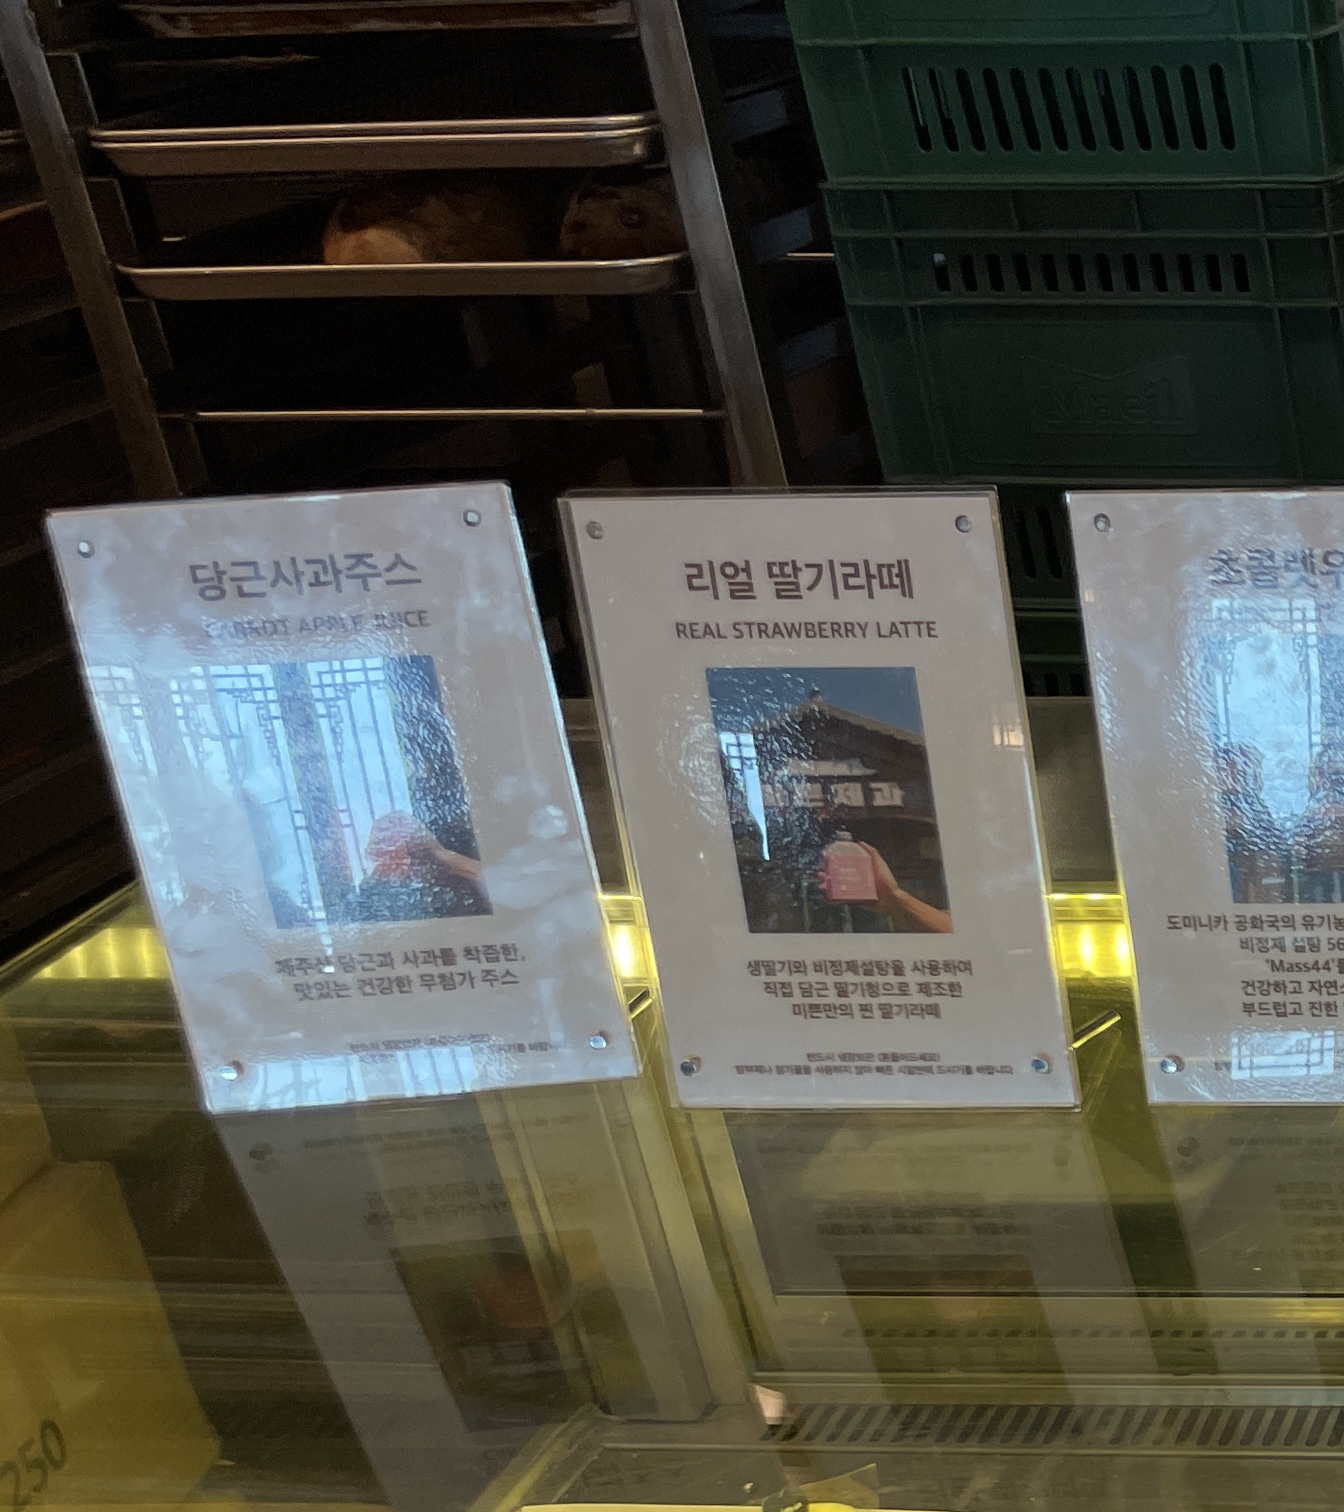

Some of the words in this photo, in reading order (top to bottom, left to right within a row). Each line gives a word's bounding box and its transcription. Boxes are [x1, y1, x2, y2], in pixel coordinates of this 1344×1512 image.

[189, 552, 422, 601] 당근사과주스
[684, 560, 757, 600] 리얼
[767, 559, 914, 600] 딸기라떼
[675, 622, 727, 640] REAL
[732, 621, 869, 639] STRAWBERRY
[876, 621, 938, 639] LATTE
[1167, 915, 1229, 932] 도미니카
[1233, 914, 1296, 932] 공화국의
[1239, 937, 1286, 954] 비정제
[402, 947, 457, 968] 사과를
[293, 979, 352, 1001] 맛있는
[357, 975, 412, 996] 건강한
[419, 971, 475, 992] 무첨가
[482, 968, 519, 987] 주스
[1240, 979, 1303, 997] 건강하고
[1241, 1001, 1303, 1018] 부드럽고
[1308, 1001, 1338, 1017] 진한
